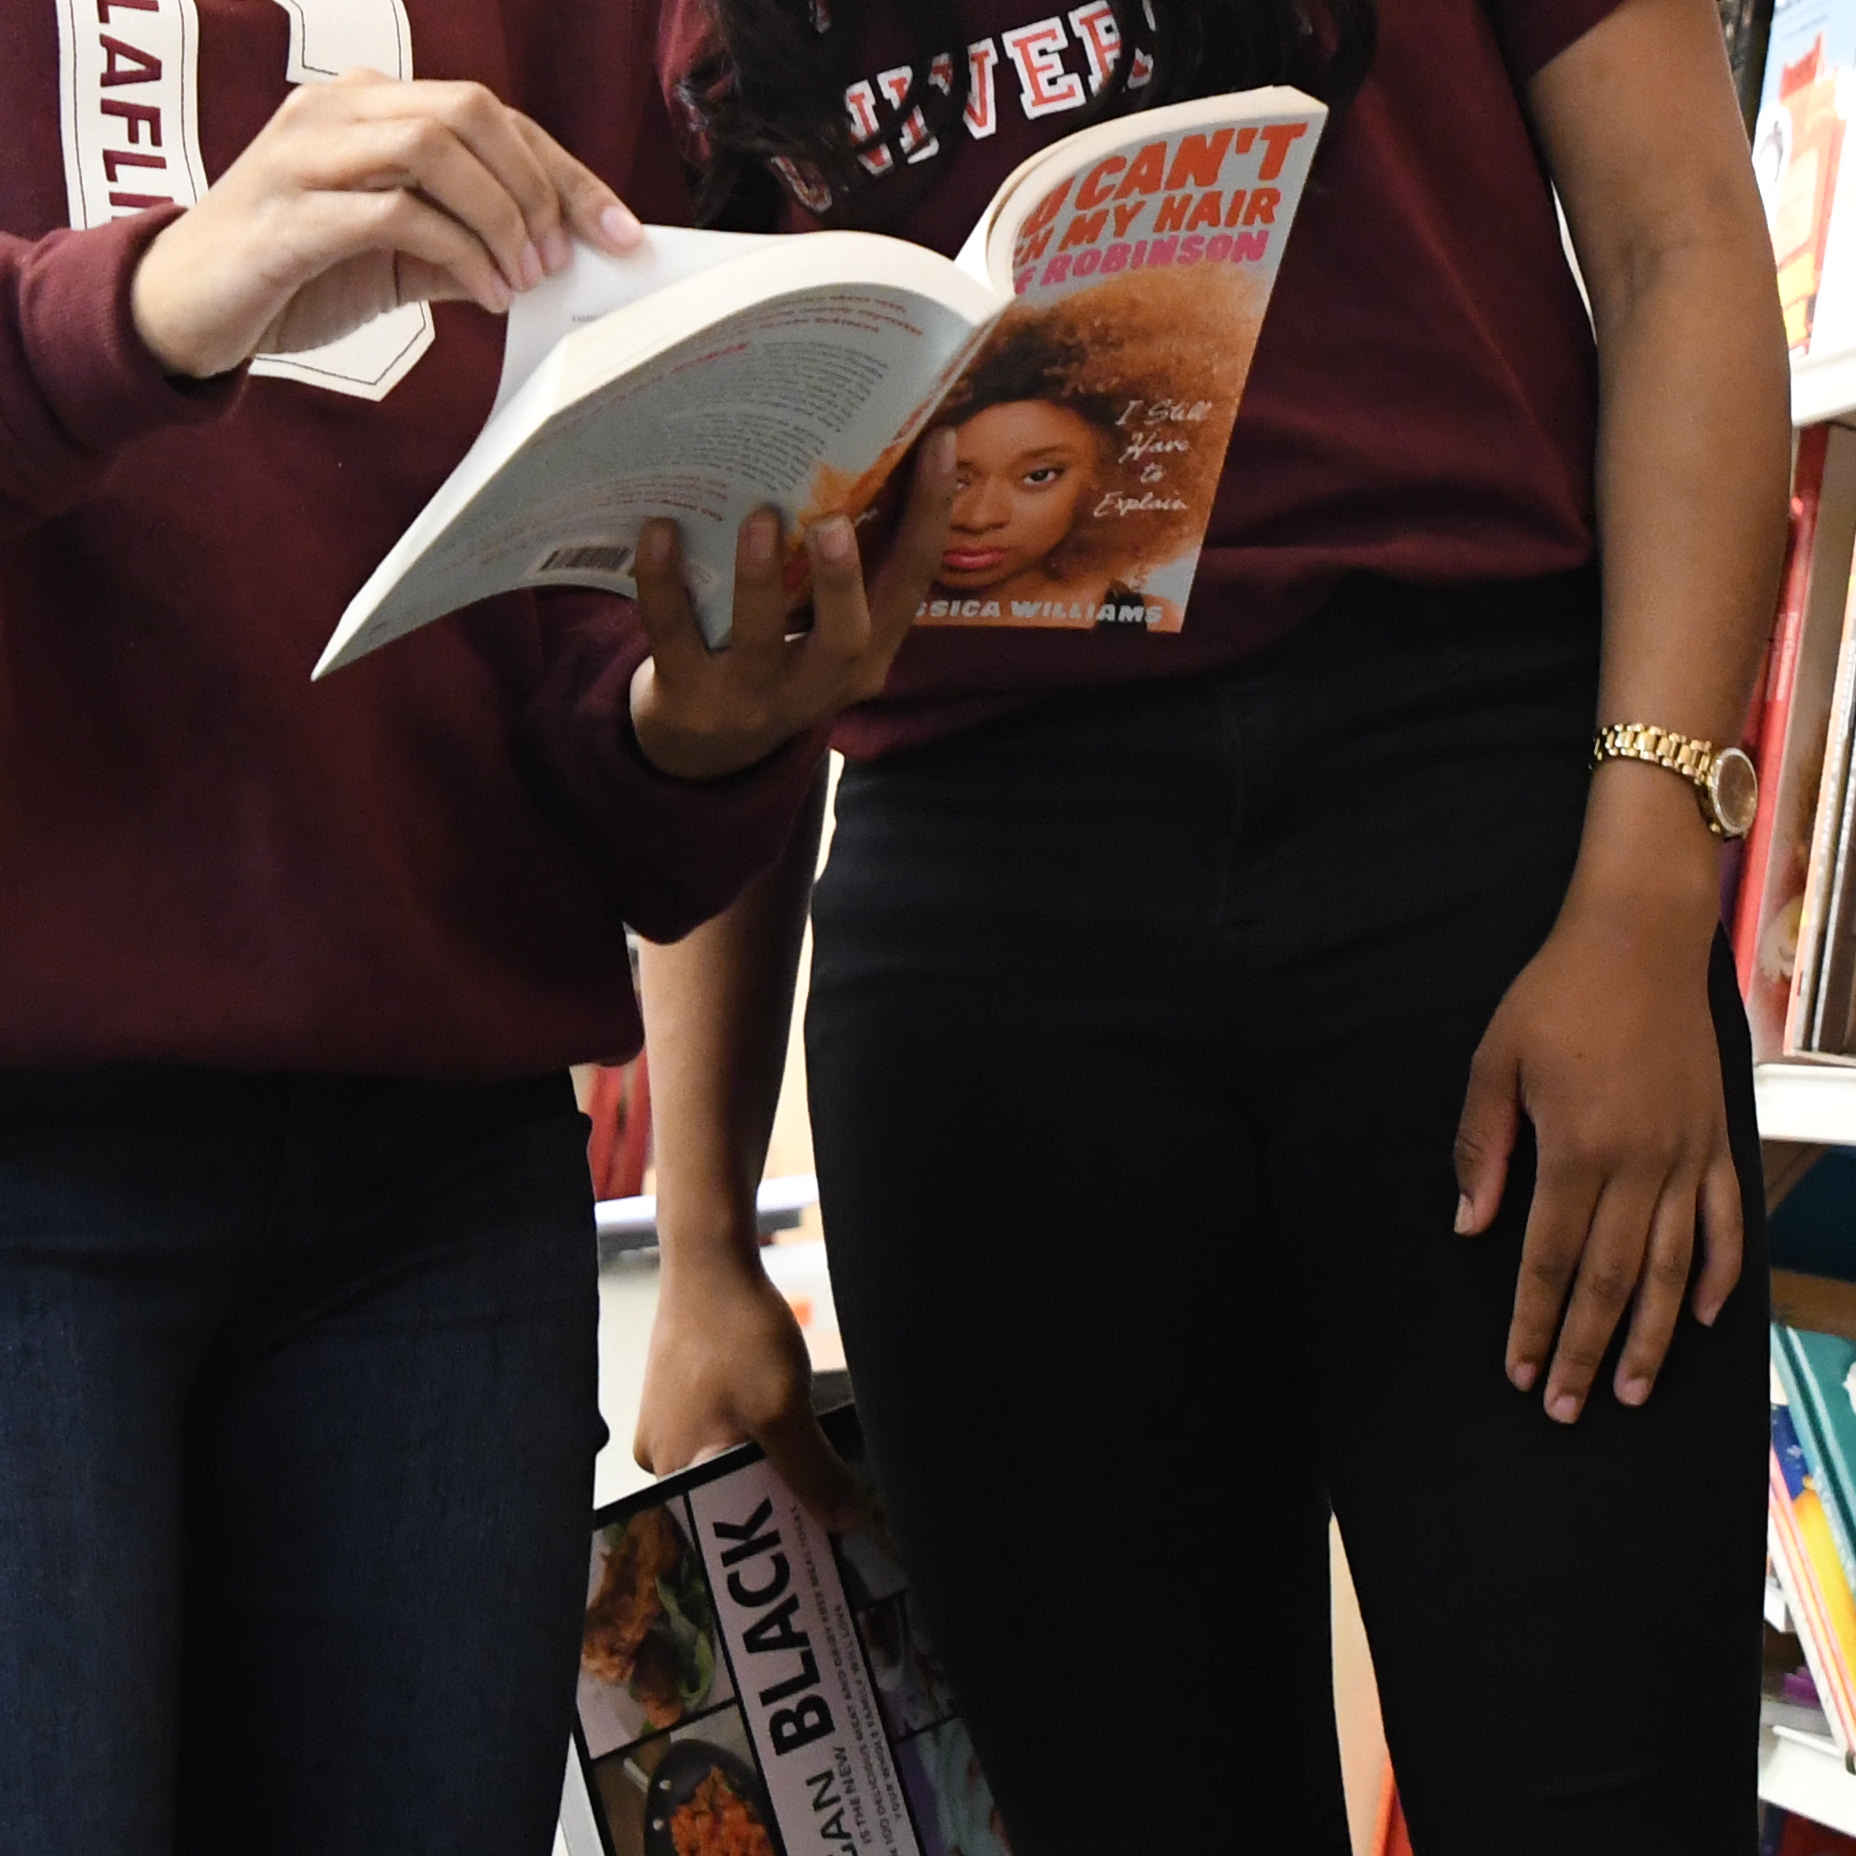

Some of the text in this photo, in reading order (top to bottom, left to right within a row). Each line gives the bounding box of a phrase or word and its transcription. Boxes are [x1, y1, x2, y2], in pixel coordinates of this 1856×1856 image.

[1074, 123, 1308, 210] CAN'T
[1060, 188, 1281, 251] MY HAIR
[1040, 230, 1268, 287] ROBINSON
[1144, 399, 1210, 427] Still
[1120, 432, 1189, 465] Have
[1140, 462, 1163, 484] to
[1093, 491, 1189, 518] Explain
[1010, 600, 1163, 624] WILLIAMS
[712, 1496, 835, 1756] BLACK
[834, 1746, 855, 1795] NEW
[850, 1798, 866, 1826] THE
